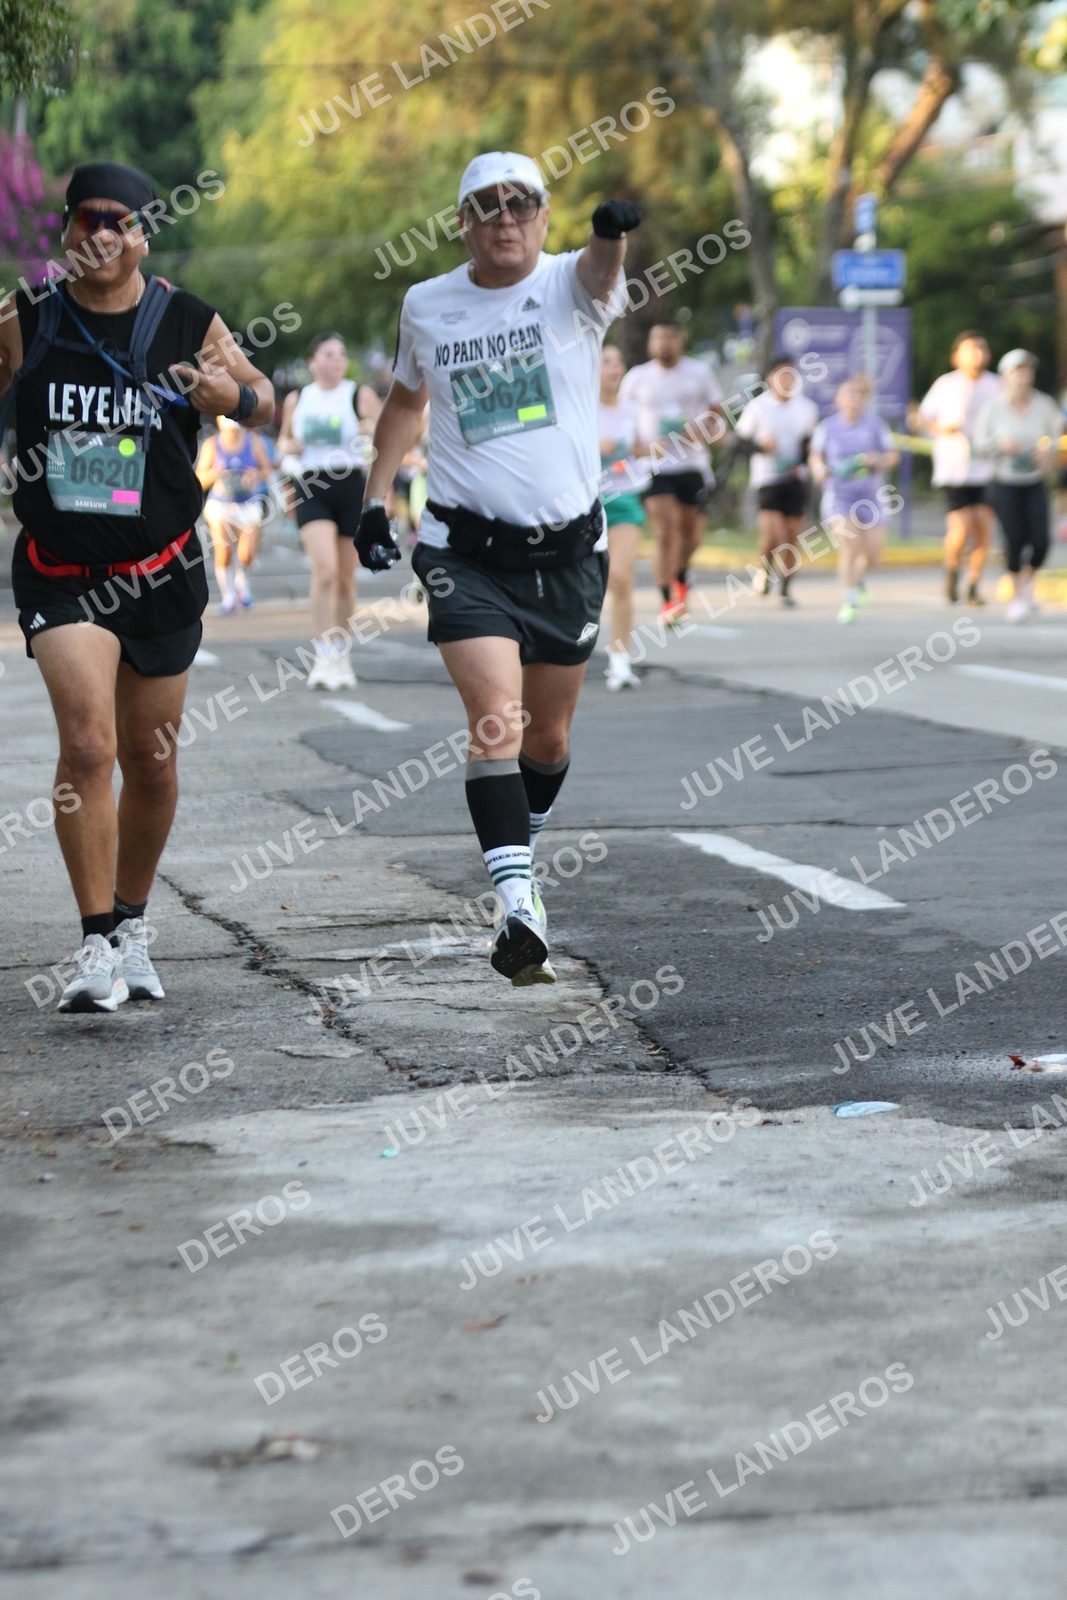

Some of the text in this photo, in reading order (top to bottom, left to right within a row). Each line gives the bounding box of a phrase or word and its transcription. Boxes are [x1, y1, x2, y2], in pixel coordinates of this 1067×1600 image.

[434, 322, 544, 368] NO PAIN NO GAIN
[480, 372, 548, 413] 0621
[70, 457, 140, 489] 0620
[74, 500, 107, 510] SAMSUNG
